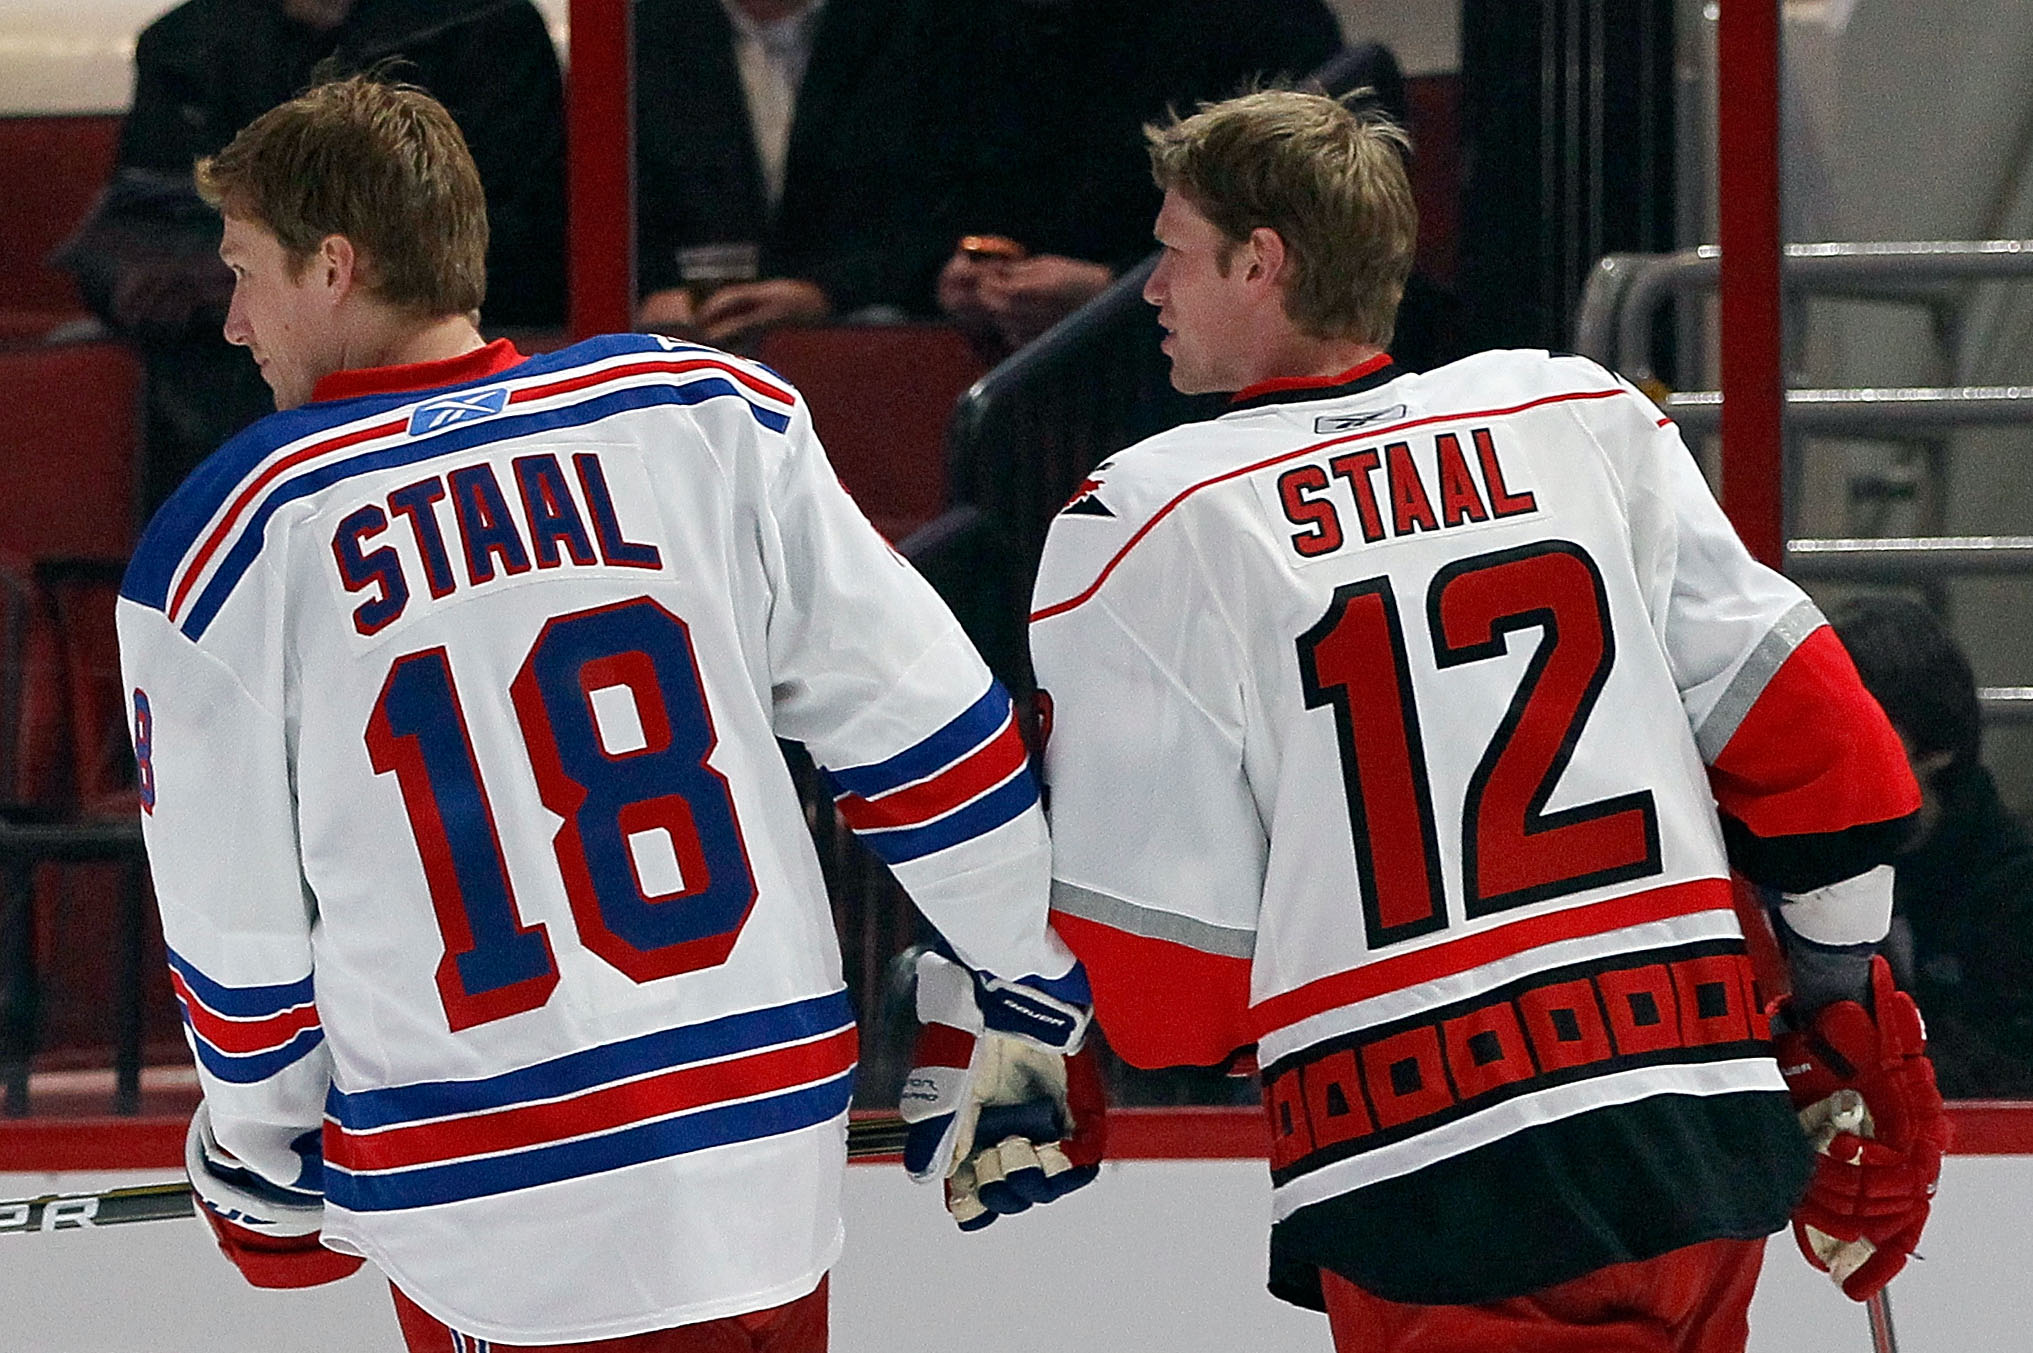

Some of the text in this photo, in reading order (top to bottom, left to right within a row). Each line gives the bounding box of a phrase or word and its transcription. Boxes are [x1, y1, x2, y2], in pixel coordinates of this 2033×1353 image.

[331, 452, 663, 636] STAAL
[1277, 428, 1539, 558] STAAL
[364, 595, 760, 1034] 18
[1295, 539, 1664, 951] 12
